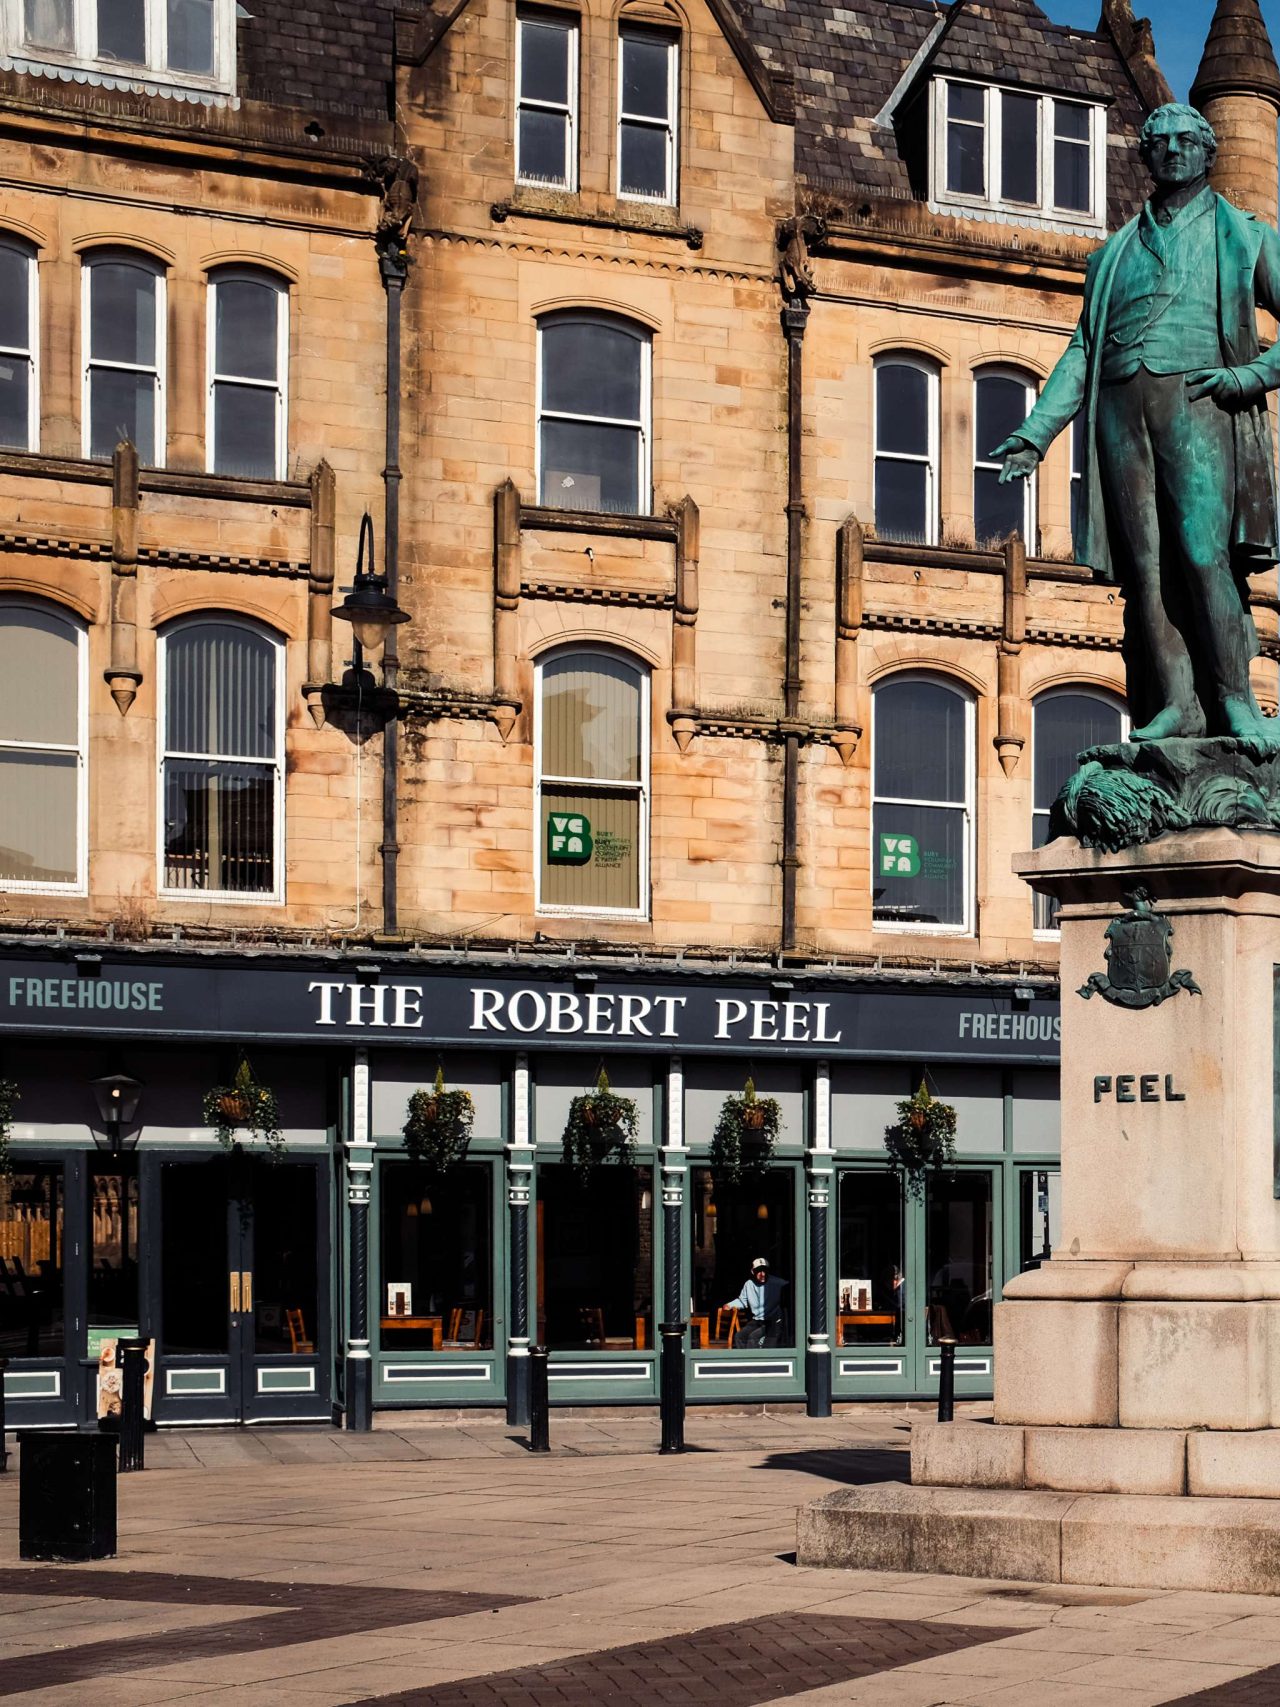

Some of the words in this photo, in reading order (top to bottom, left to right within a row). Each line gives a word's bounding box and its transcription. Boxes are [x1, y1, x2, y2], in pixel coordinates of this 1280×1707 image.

[552, 817, 583, 834] VC
[552, 835, 583, 852] FA
[883, 838, 911, 854] VC
[883, 855, 911, 872] FA
[9, 977, 163, 1011] FREEHOUSE
[307, 981, 424, 1029] THE
[469, 988, 687, 1037] ROBERT
[714, 998, 842, 1043] PEEL
[959, 1013, 1060, 1041] FREEHOUS
[1094, 1074, 1186, 1103] PEEL
